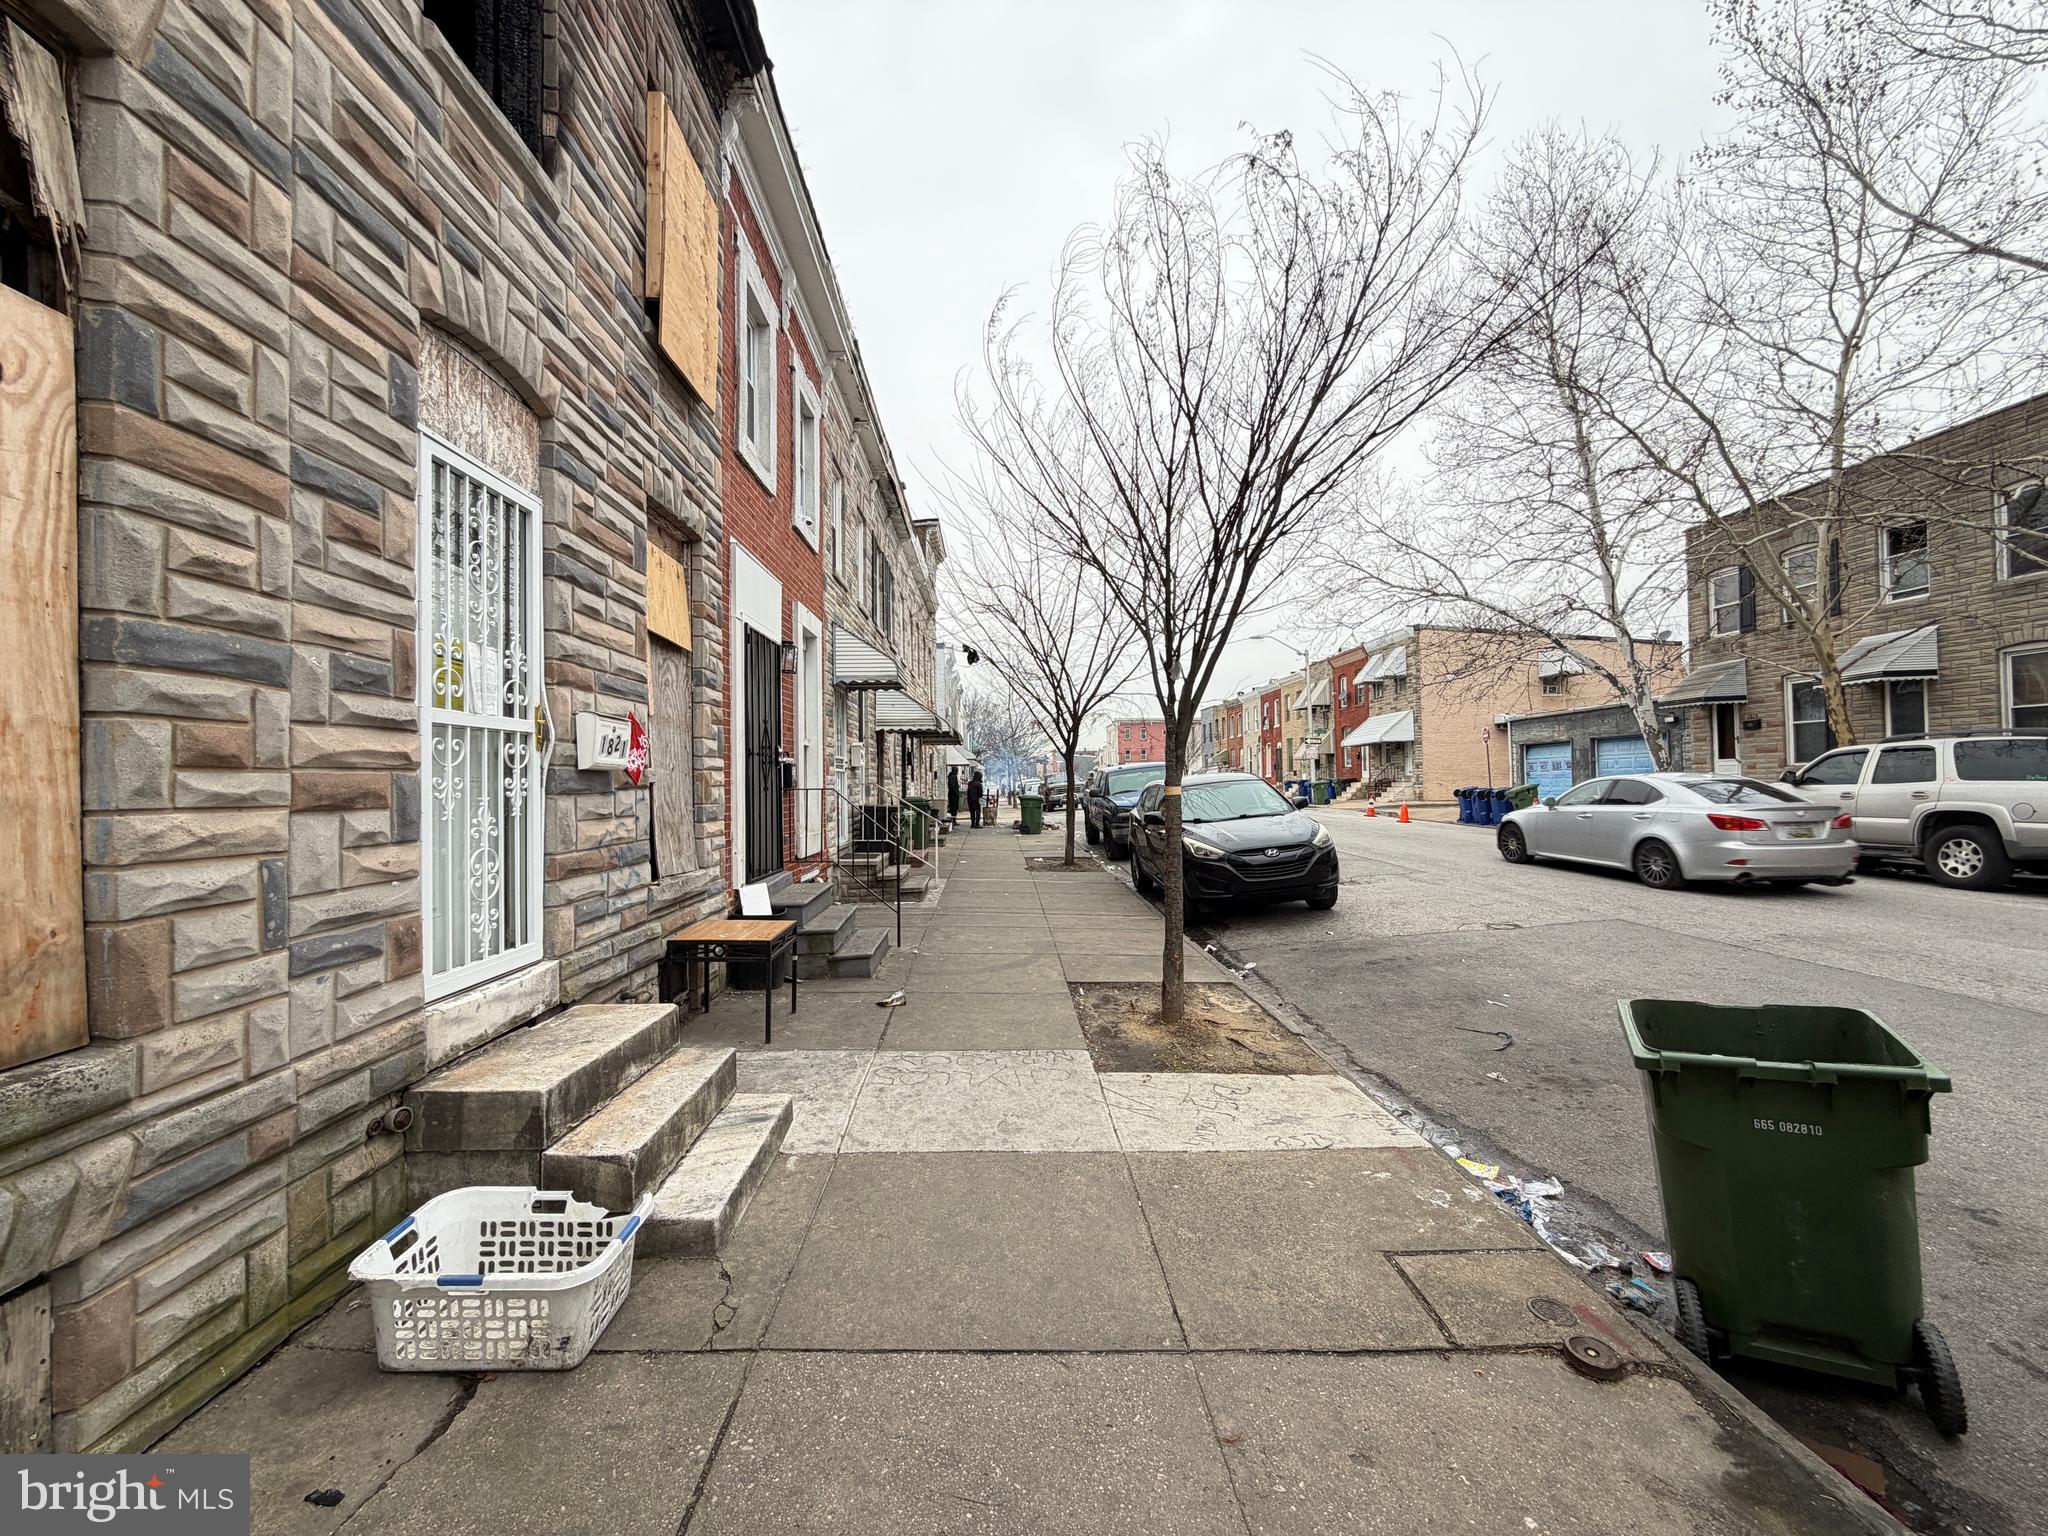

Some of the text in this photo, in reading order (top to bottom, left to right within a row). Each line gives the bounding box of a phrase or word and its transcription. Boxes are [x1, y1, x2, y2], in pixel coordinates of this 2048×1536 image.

[601, 735, 626, 757] 1821
[1753, 1119, 1823, 1136] 665 082810
